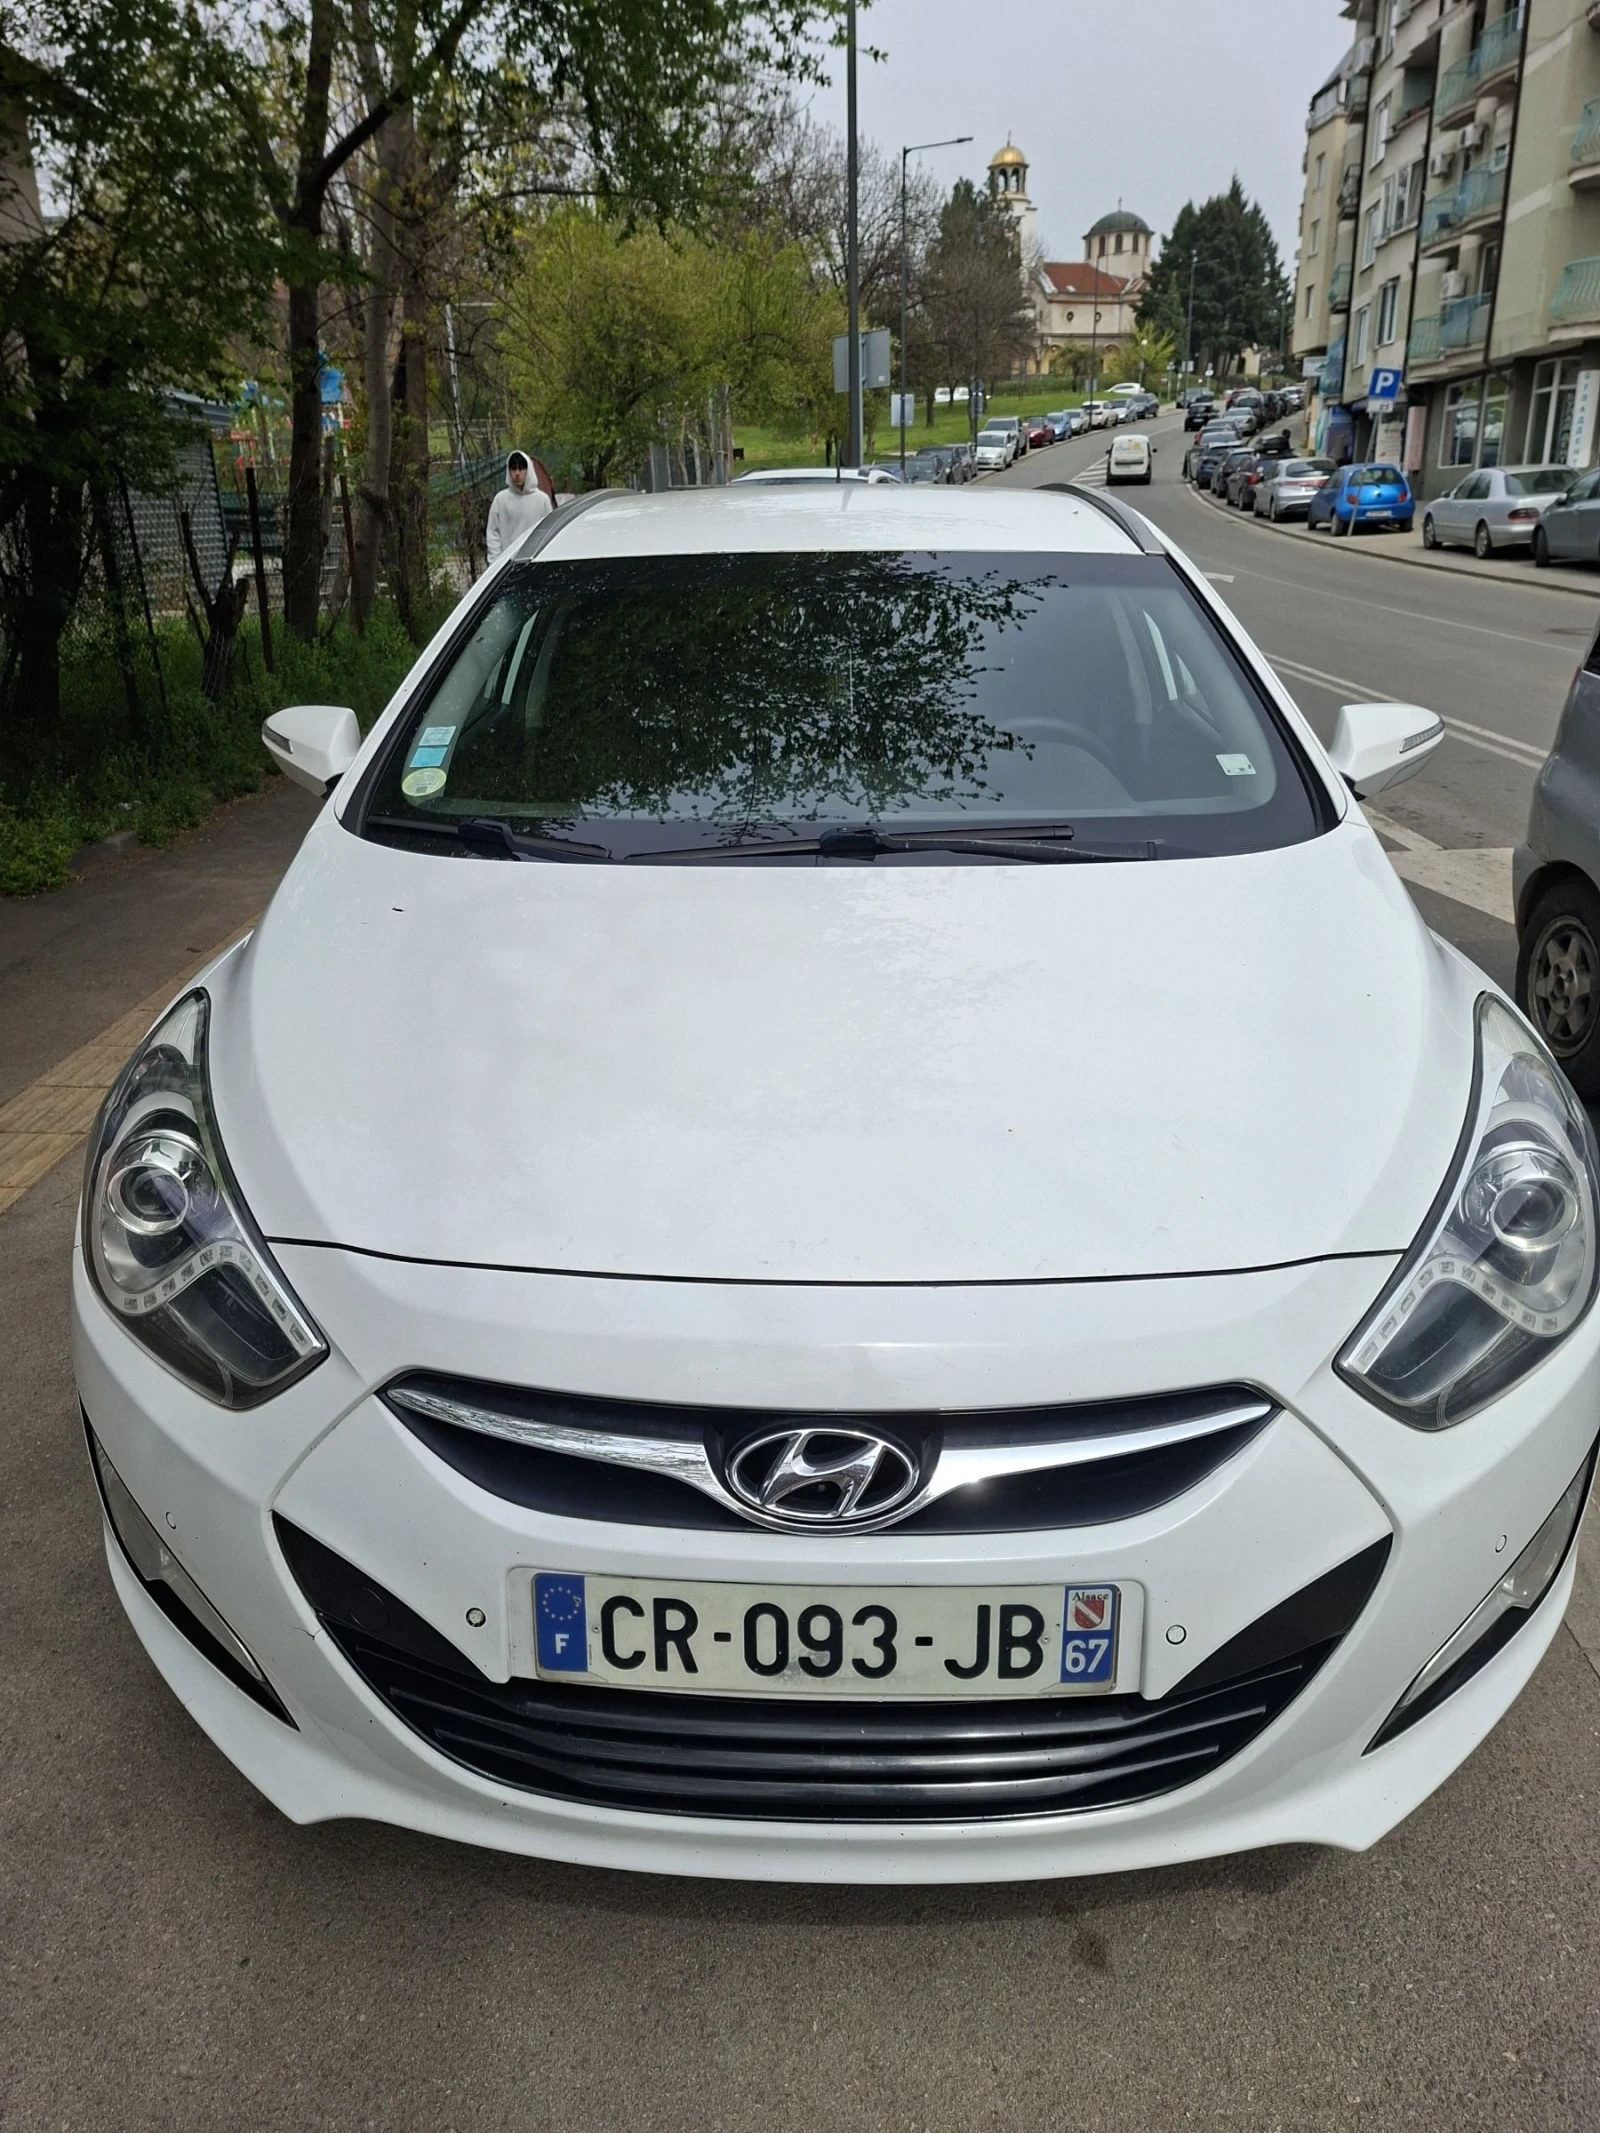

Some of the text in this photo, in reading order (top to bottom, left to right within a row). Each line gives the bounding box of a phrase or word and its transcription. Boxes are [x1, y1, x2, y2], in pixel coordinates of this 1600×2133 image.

[1072, 1591, 1109, 1601] Alsace
[555, 1633, 570, 1654] F
[600, 1595, 1046, 1680] CR-093-JB
[1065, 1639, 1109, 1674] 67
